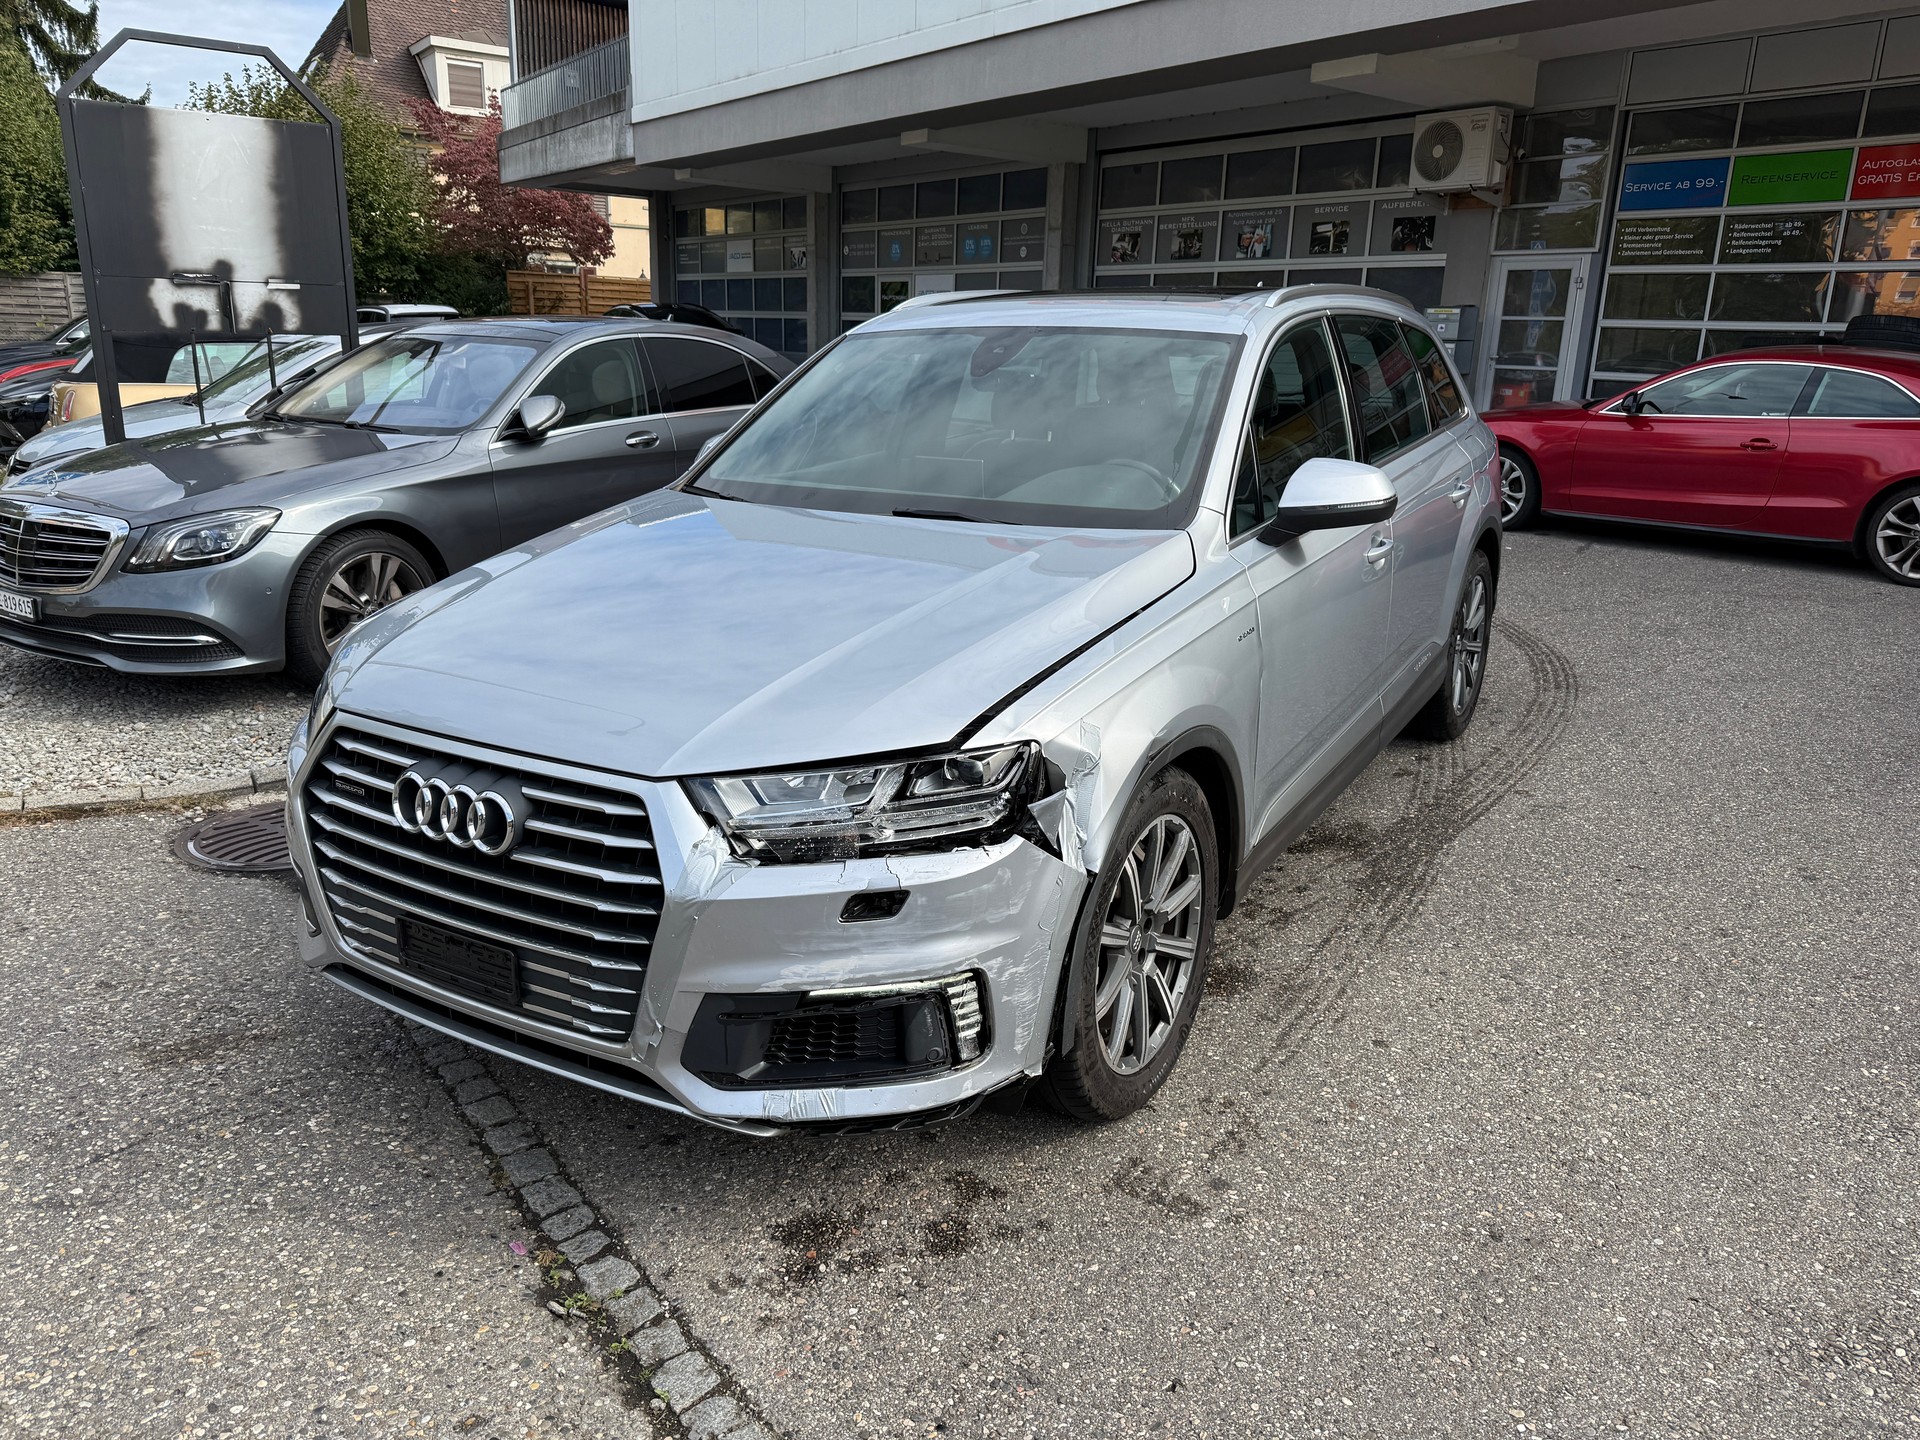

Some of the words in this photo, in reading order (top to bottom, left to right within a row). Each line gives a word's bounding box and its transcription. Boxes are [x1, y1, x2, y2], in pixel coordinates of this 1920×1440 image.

[1741, 170, 1838, 184] REIFENSERVICE
[1857, 173, 1902, 185] GRATIS
[1625, 182, 1672, 193] SERVICE
[1675, 181, 1690, 189] AB
[1695, 178, 1724, 188] 99.-
[1122, 219, 1153, 227] GUTMANN
[1159, 221, 1217, 230] BEREITSTELLUNG
[1732, 230, 1774, 238] Reifenwechsel
[1662, 248, 1704, 256] Getriebeservice
[1729, 247, 1772, 255] Lenkgeometrie
